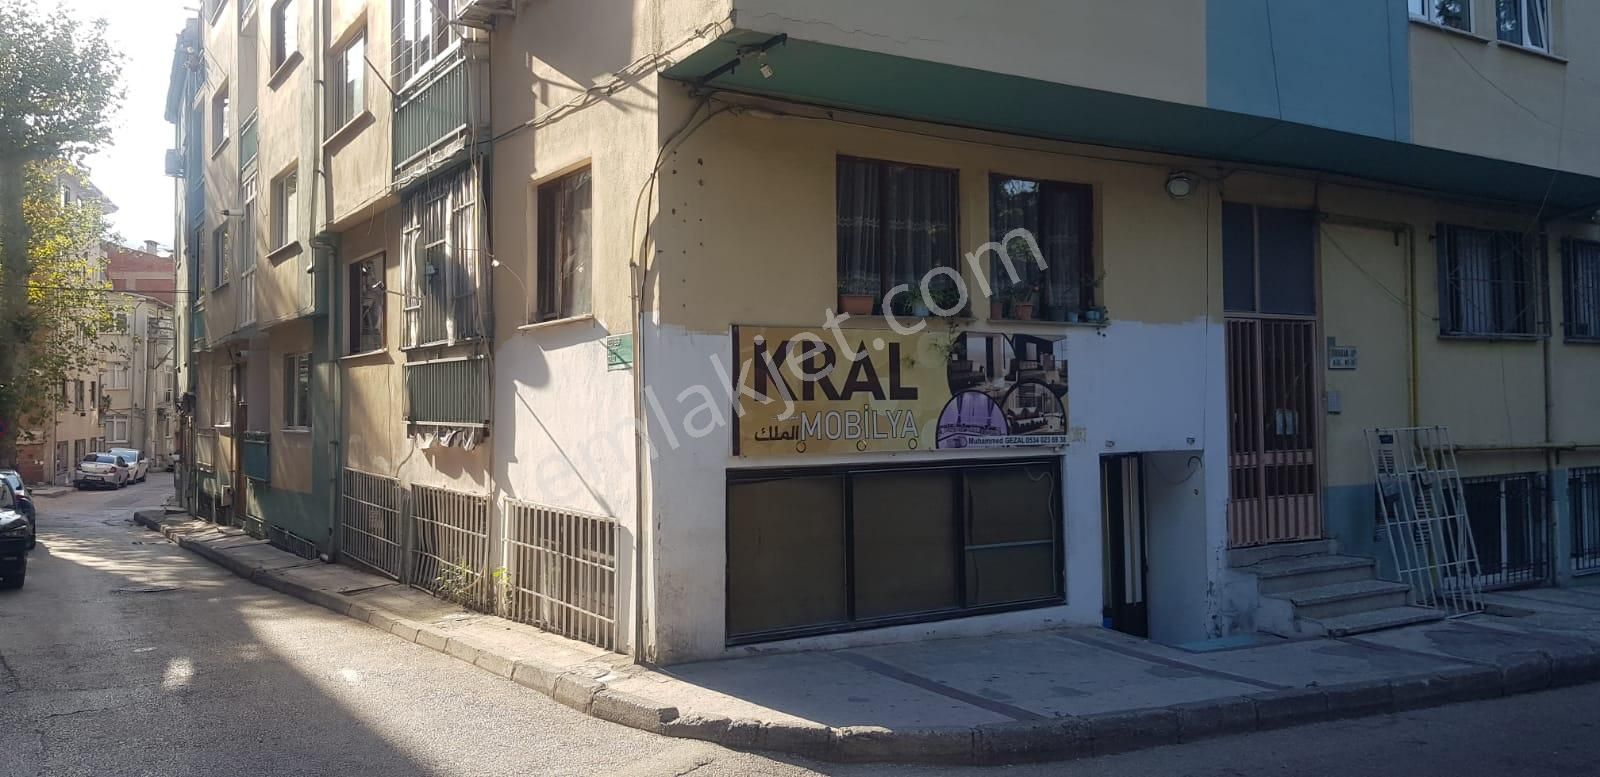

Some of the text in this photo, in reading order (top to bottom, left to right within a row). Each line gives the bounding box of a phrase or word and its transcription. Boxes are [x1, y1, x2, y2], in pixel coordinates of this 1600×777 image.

[754, 340, 918, 401] KRAL
[754, 425, 800, 441] الملك
[802, 404, 919, 441] MOBİLYA
